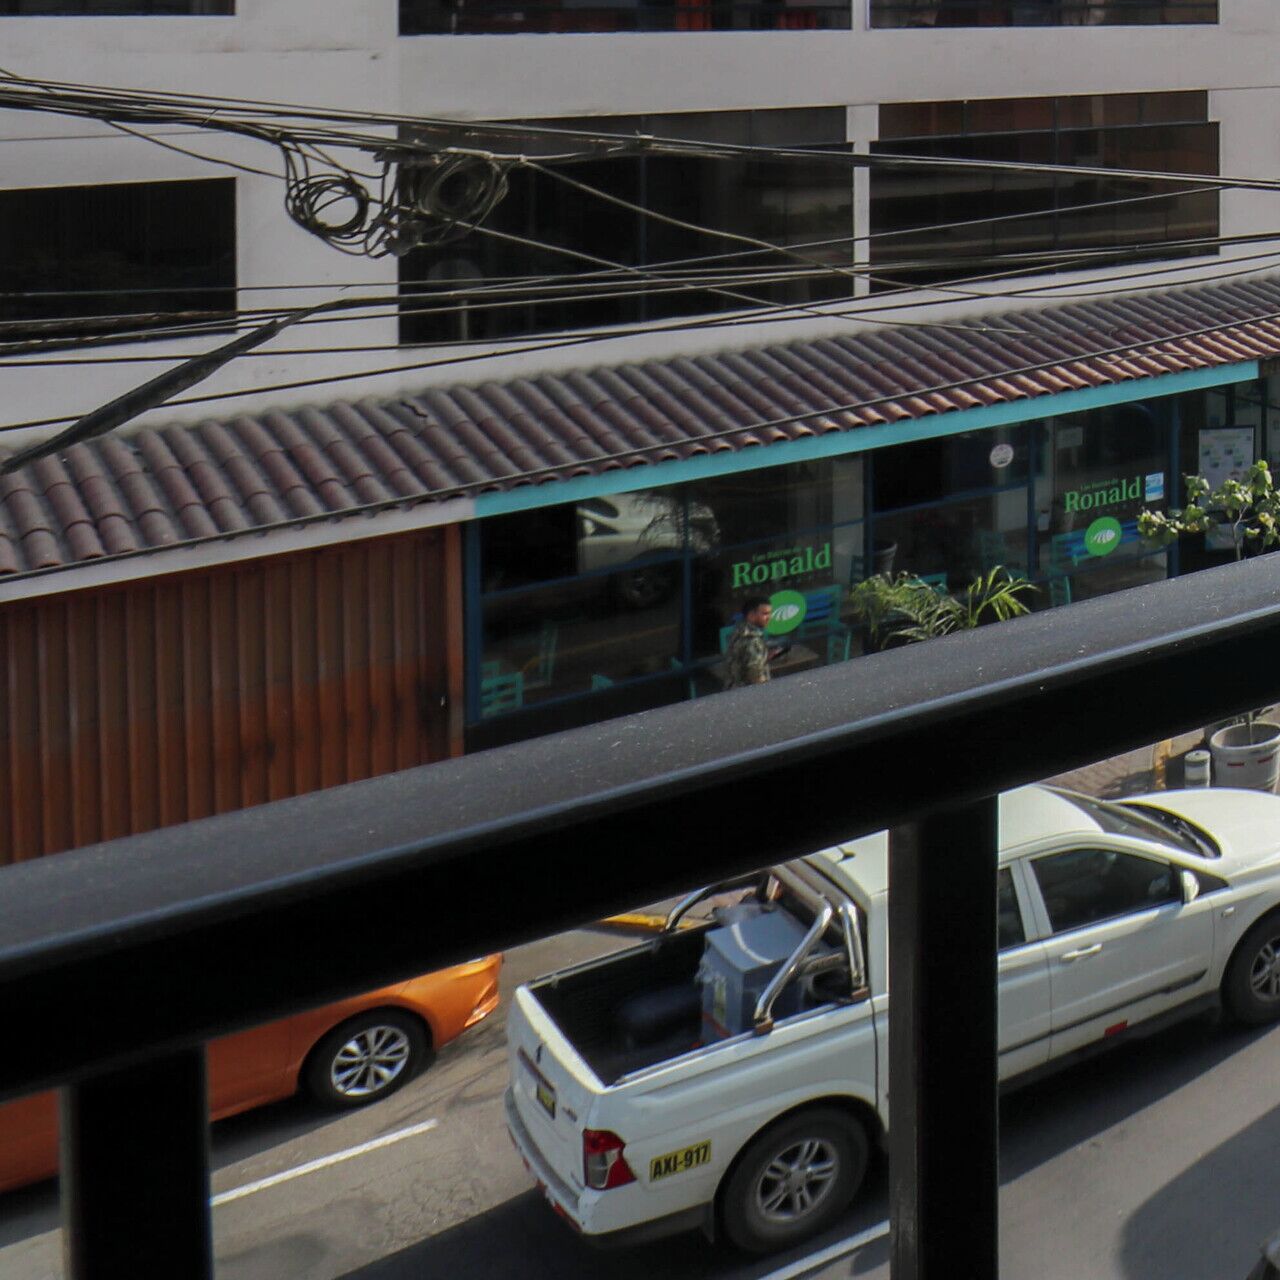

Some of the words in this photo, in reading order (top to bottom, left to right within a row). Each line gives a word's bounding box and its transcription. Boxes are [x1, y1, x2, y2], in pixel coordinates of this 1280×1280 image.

[1064, 475, 1141, 513] Ronald
[731, 542, 832, 589] Ronald
[653, 1143, 709, 1180] AXI-917
